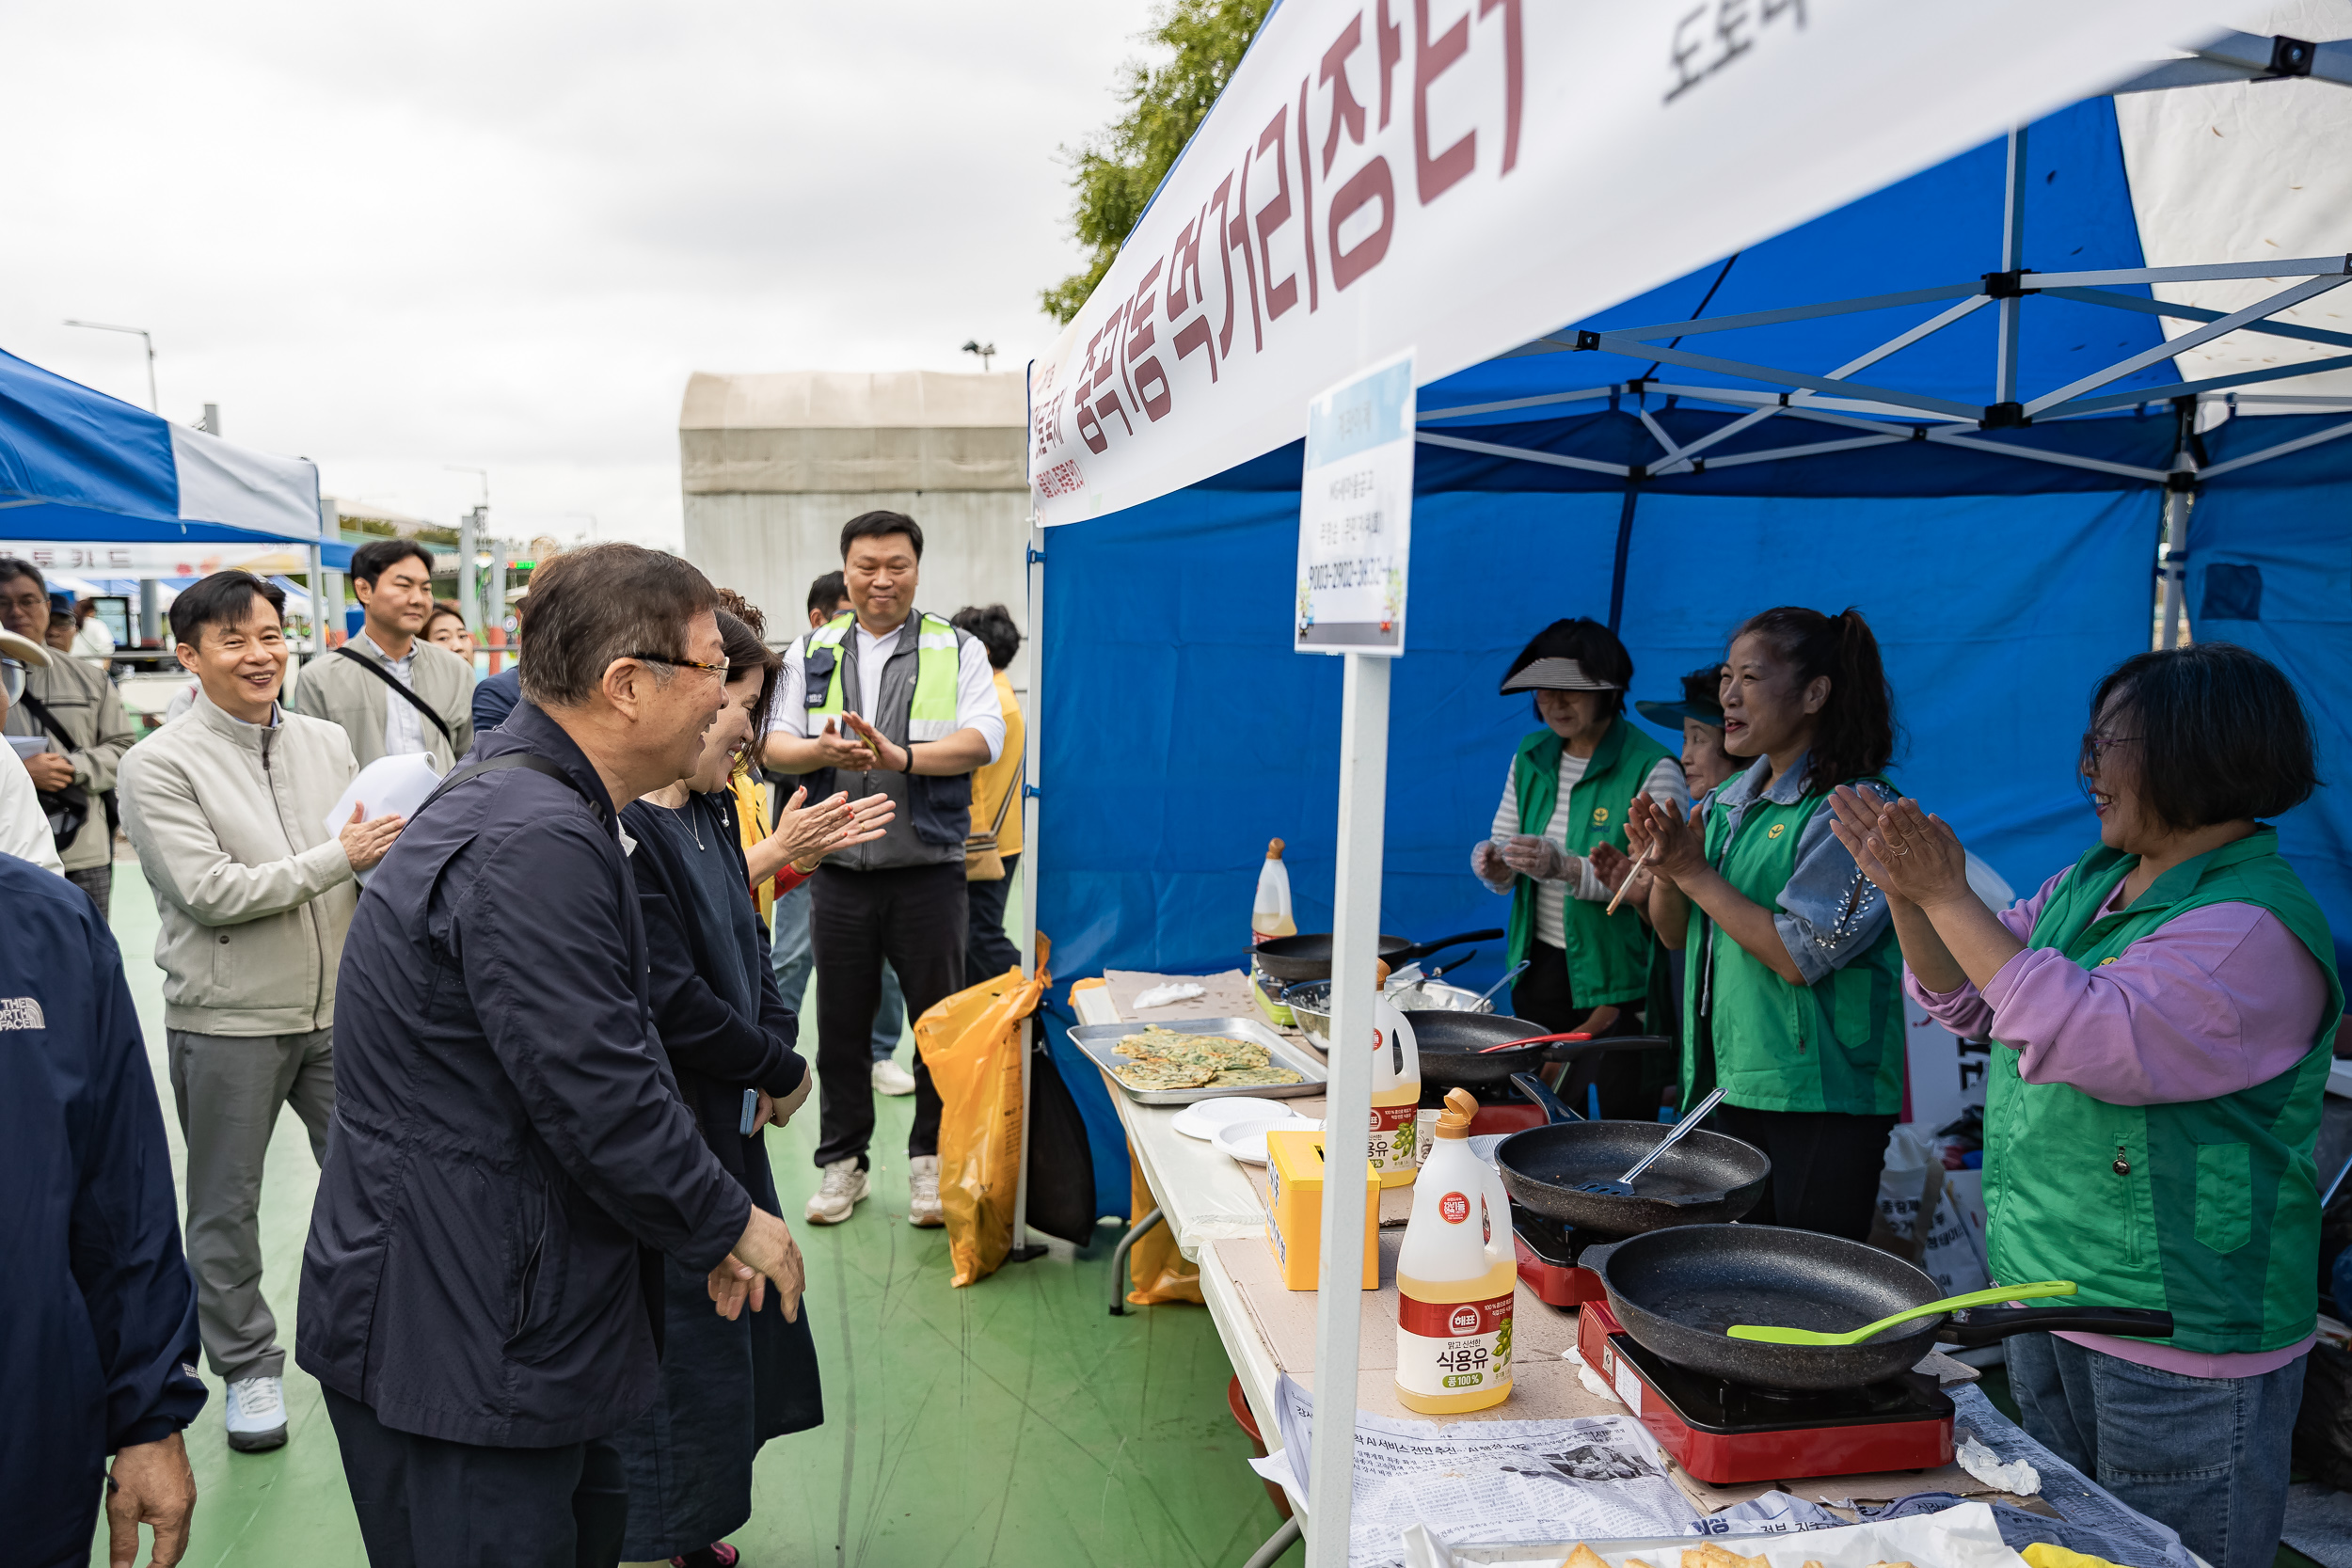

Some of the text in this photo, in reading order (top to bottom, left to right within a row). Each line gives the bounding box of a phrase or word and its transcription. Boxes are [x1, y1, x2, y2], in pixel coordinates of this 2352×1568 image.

[1073, 256, 1172, 455] 중곡동
[1, 998, 26, 1009] THE
[0, 1018, 31, 1031] FACE
[1454, 1314, 1475, 1326] 해표
[1448, 1338, 1481, 1350] 맑고 신선한
[1437, 1348, 1488, 1372] 식용유
[1448, 1376, 1456, 1387] 콩
[1366, 1436, 1376, 1447] AI
[1378, 1439, 1409, 1453] 서비스
[1410, 1446, 1433, 1455] 전면
